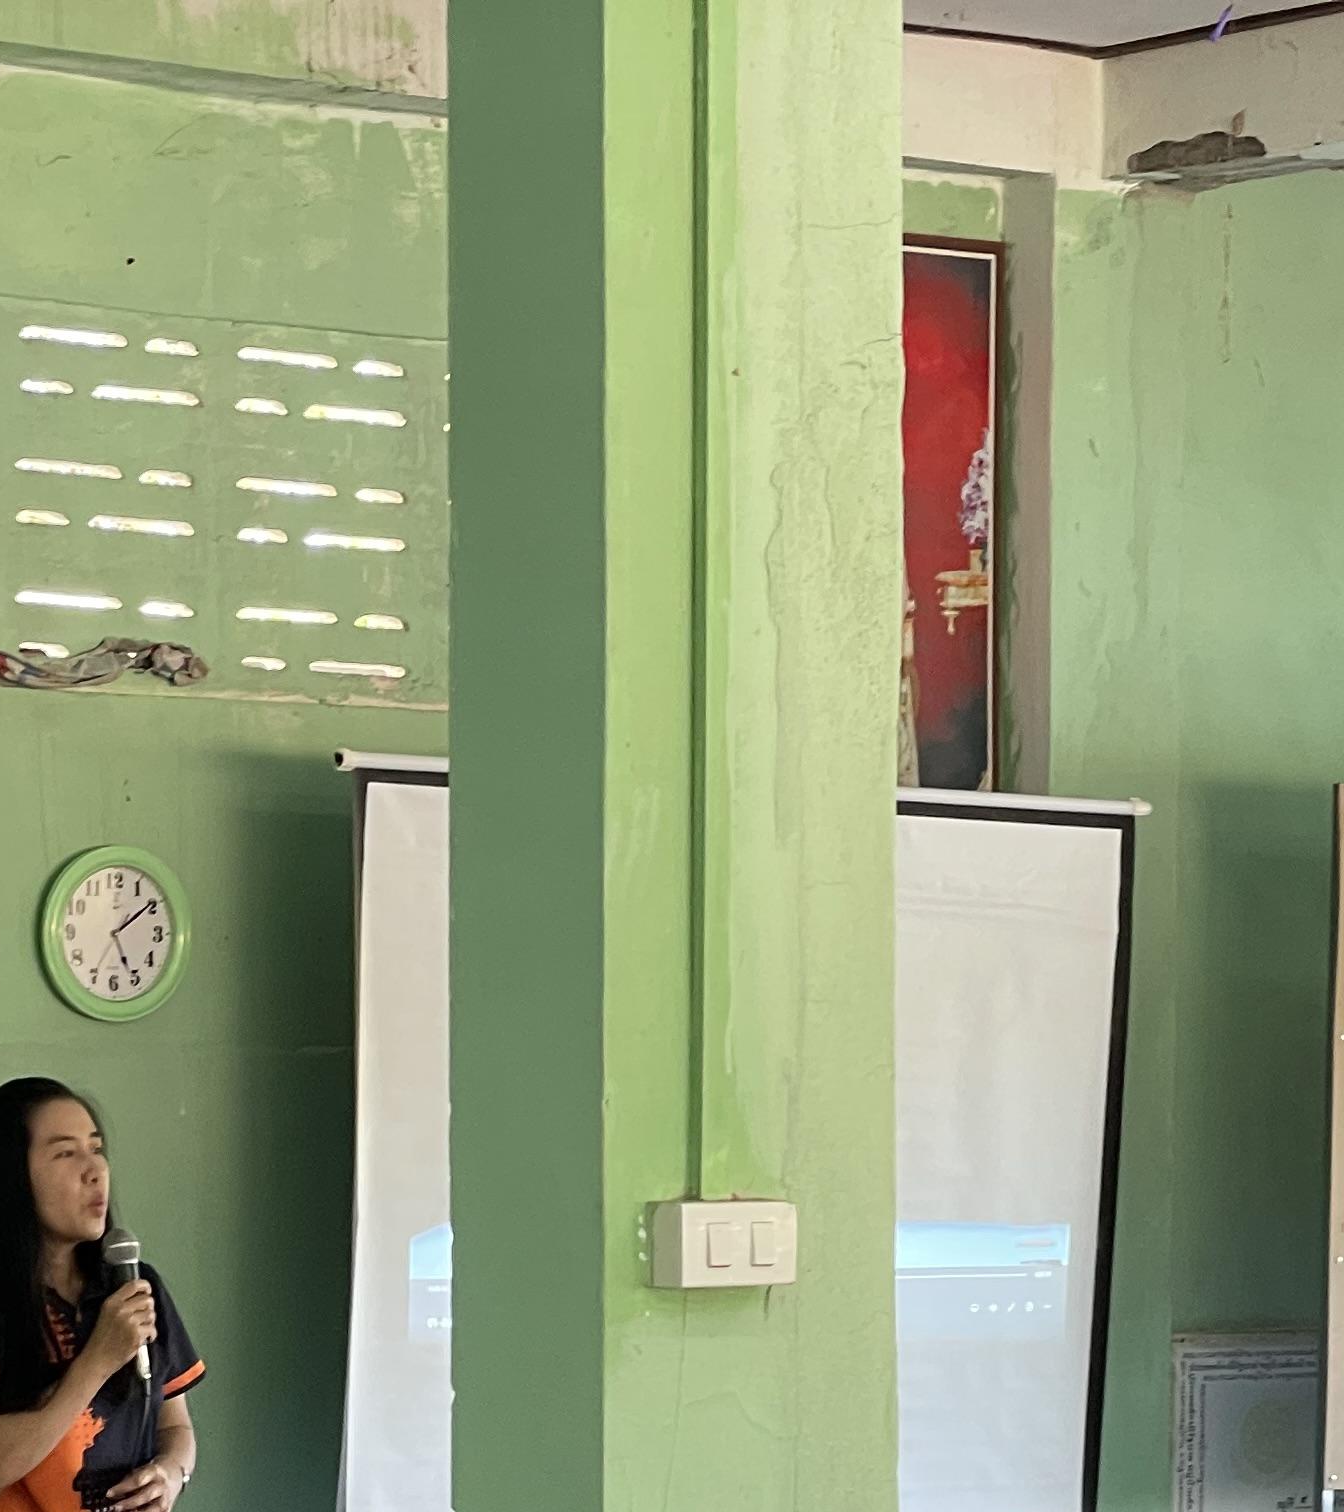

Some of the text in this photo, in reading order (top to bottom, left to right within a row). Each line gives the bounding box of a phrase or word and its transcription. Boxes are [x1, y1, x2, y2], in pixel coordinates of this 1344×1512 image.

[106, 872, 124, 889] 12
[152, 925, 164, 943] 3
[144, 950, 154, 967] 4
[108, 975, 119, 991] 6
